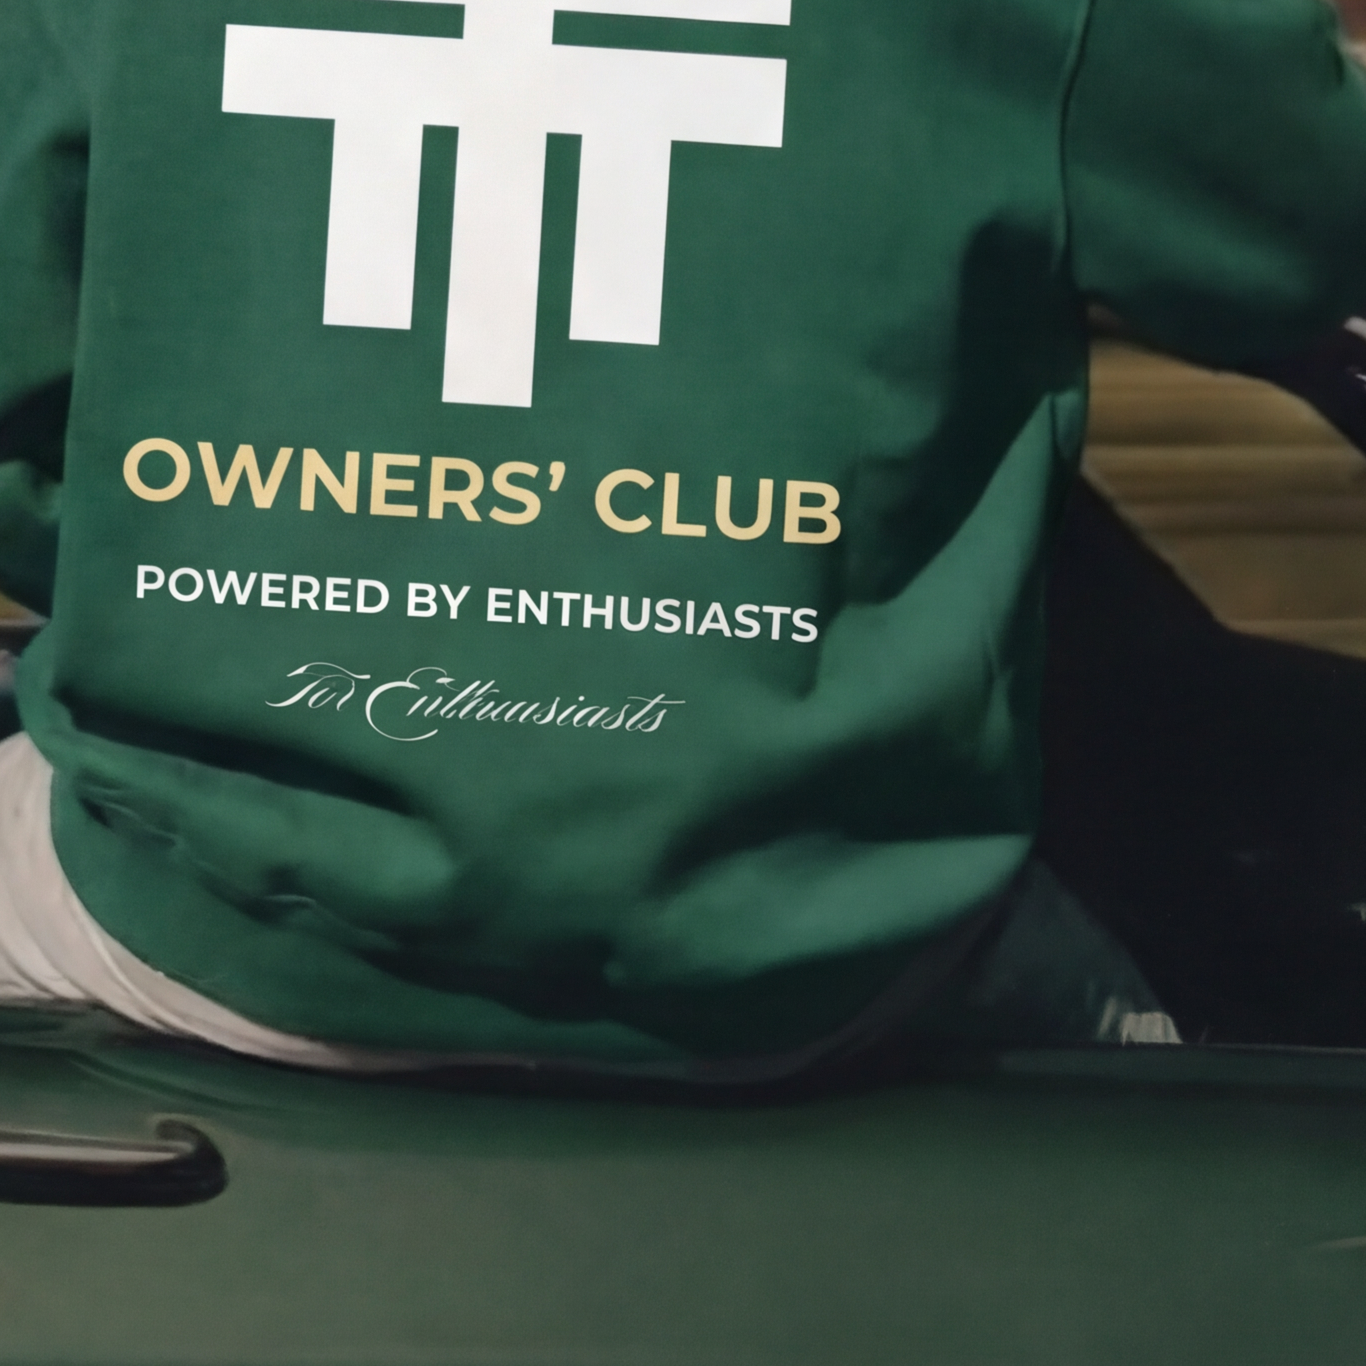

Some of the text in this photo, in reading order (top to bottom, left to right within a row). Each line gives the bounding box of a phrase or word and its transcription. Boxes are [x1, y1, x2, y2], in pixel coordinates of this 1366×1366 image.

[122, 437, 842, 545] OWNERS’ CLUB
[136, 564, 818, 643] POWERED BY ENTHUSIASTS
